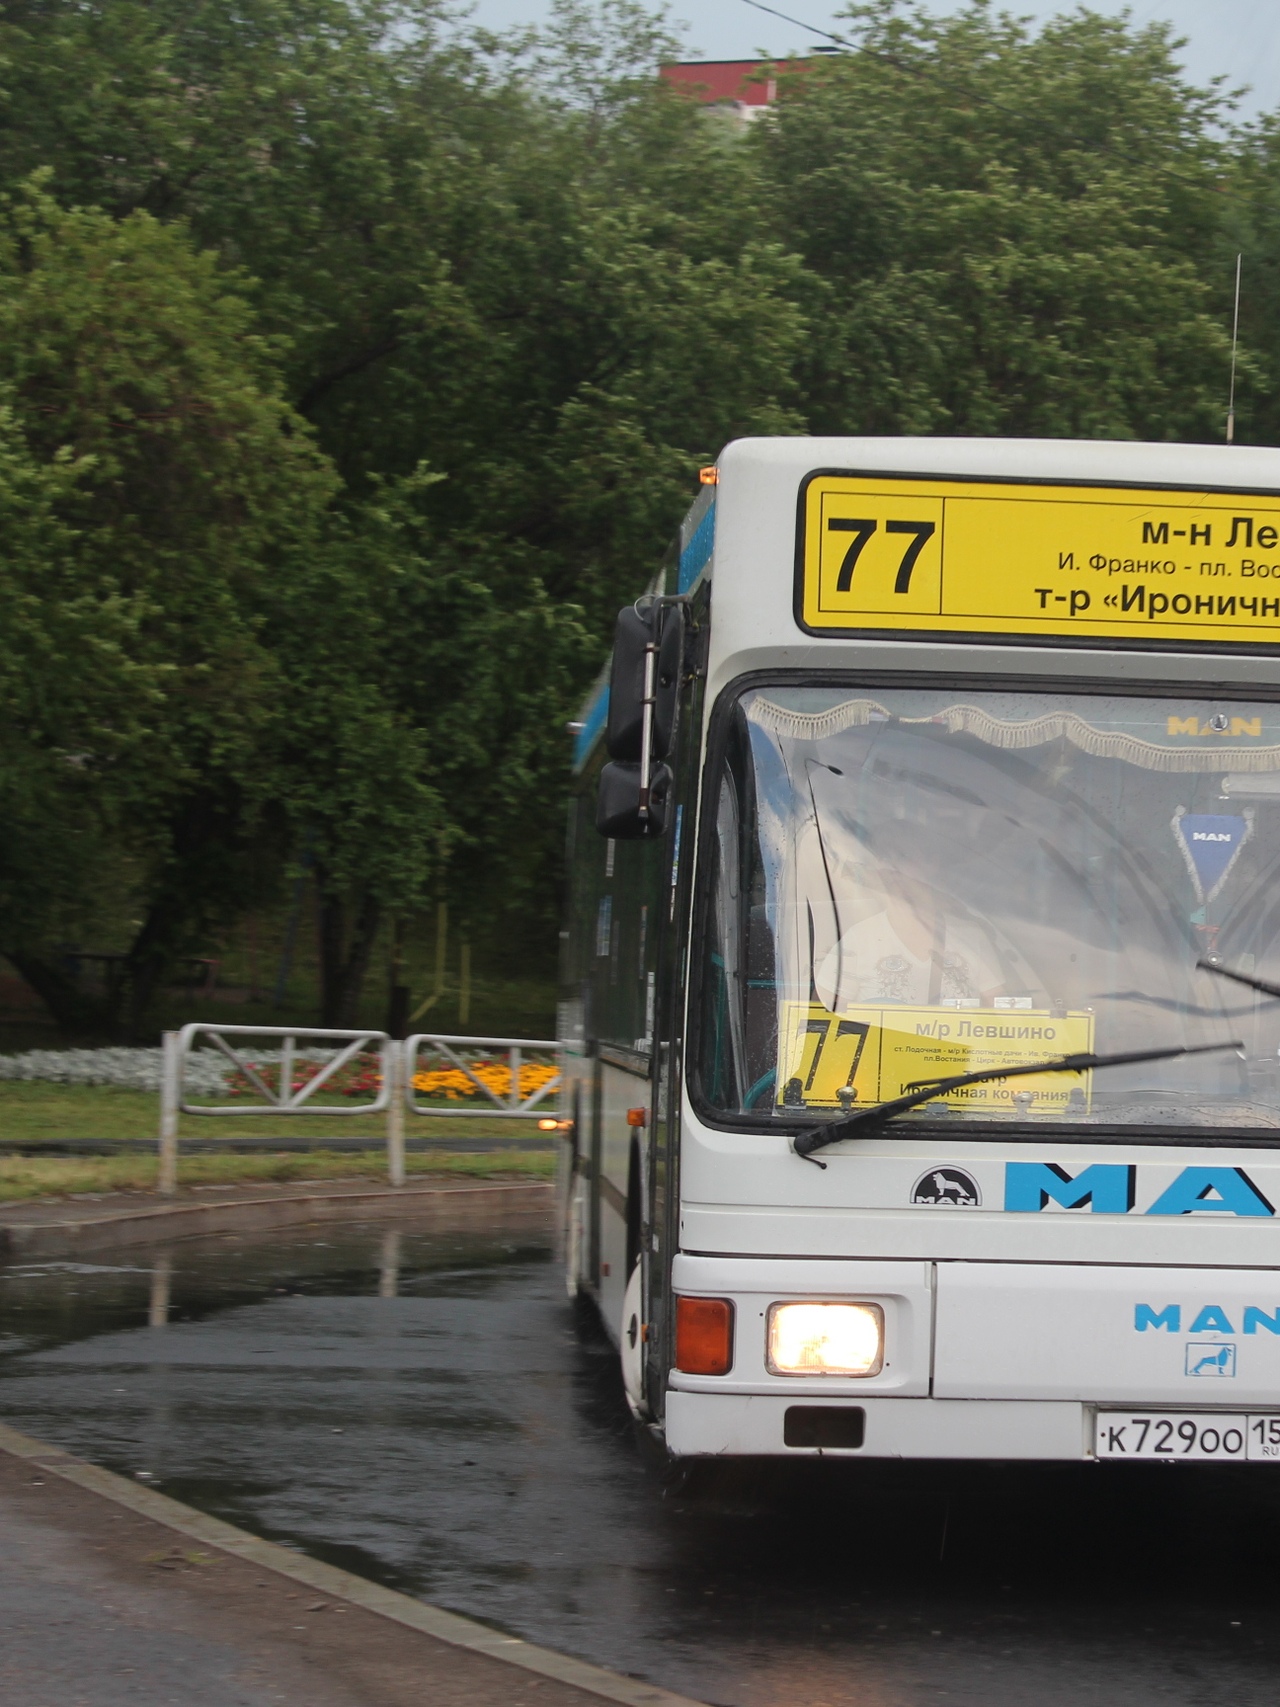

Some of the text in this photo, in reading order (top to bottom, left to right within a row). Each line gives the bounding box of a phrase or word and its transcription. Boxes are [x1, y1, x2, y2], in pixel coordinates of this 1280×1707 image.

[1142, 522, 1211, 546] м-н
[827, 517, 936, 594] 77
[1058, 552, 1080, 571] И.
[1089, 553, 1177, 577] Франко
[1200, 562, 1232, 577] пл.
[1034, 587, 1091, 616] т-р
[1167, 716, 1262, 736] MAN
[1193, 832, 1231, 842] MAN
[915, 1020, 1056, 1041] м/р Левшино
[797, 1019, 871, 1092] 77
[962, 1048, 1003, 1056] Кислотные
[916, 1195, 976, 1206] MAN
